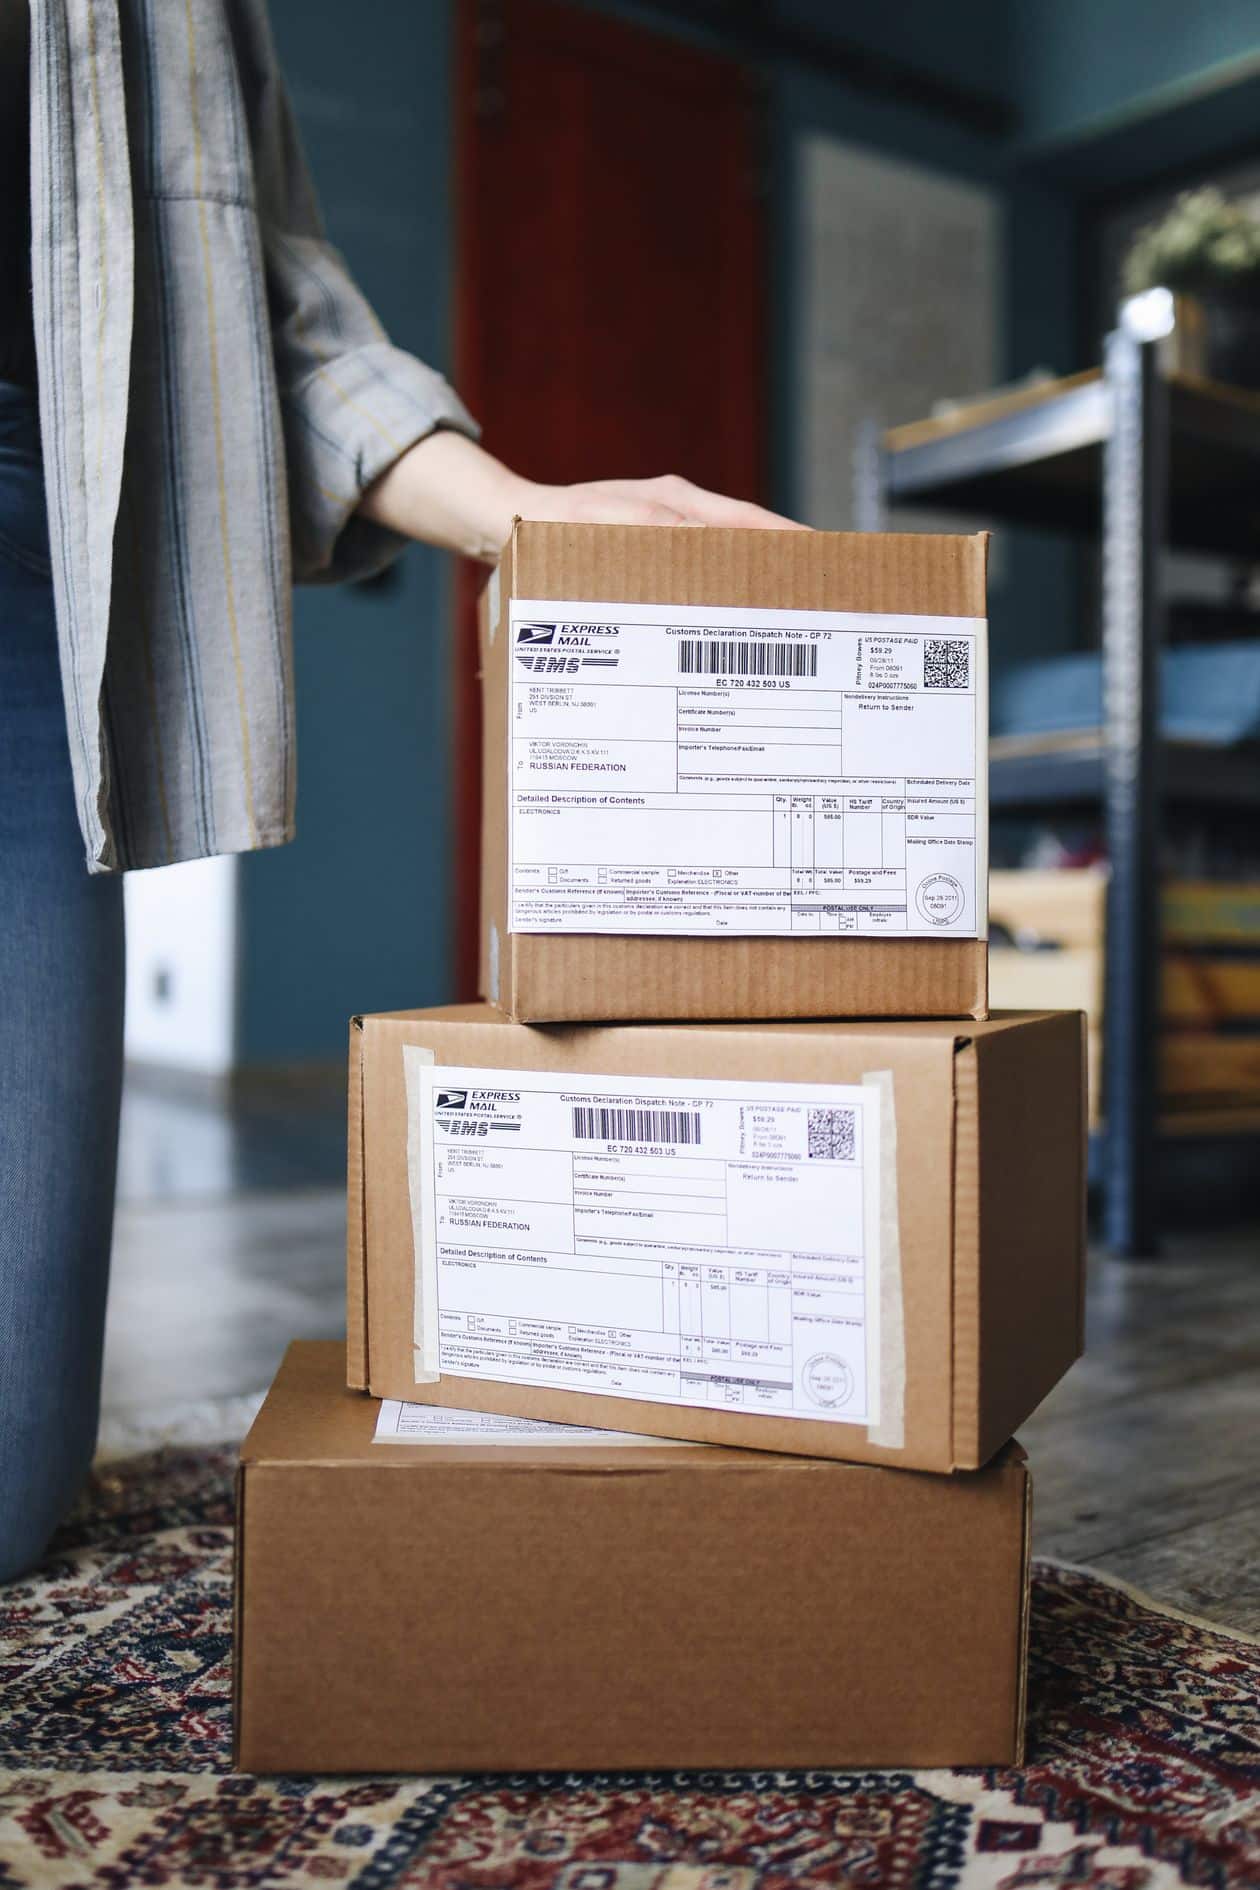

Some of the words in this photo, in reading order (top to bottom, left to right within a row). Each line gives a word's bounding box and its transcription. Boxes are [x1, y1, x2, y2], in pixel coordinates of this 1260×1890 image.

[561, 625, 620, 634] EXPRESS
[703, 628, 746, 637] Declaration
[750, 630, 782, 639] Dispatch
[558, 637, 591, 645] MAIL
[533, 657, 580, 673] EMS
[763, 680, 776, 688] 503
[530, 762, 568, 770] RUSSIAN
[571, 763, 626, 771] FEDERATION
[551, 795, 597, 805] Description
[472, 1091, 521, 1101] EXPRESS
[560, 1095, 590, 1103] Customs
[593, 1096, 633, 1105] Declaration
[635, 1098, 667, 1107] Dispatch
[669, 1099, 685, 1107] Note
[470, 1103, 496, 1111] MAIL
[450, 1120, 488, 1136] EMS
[620, 1145, 632, 1153] 720
[650, 1147, 662, 1155] 503
[665, 1148, 676, 1156] US
[450, 1218, 481, 1227] RUSSIAN
[483, 1221, 530, 1231] FEDERATION
[440, 1248, 466, 1256] Detailed
[468, 1250, 506, 1260] Description
[517, 1255, 547, 1263] Contents
